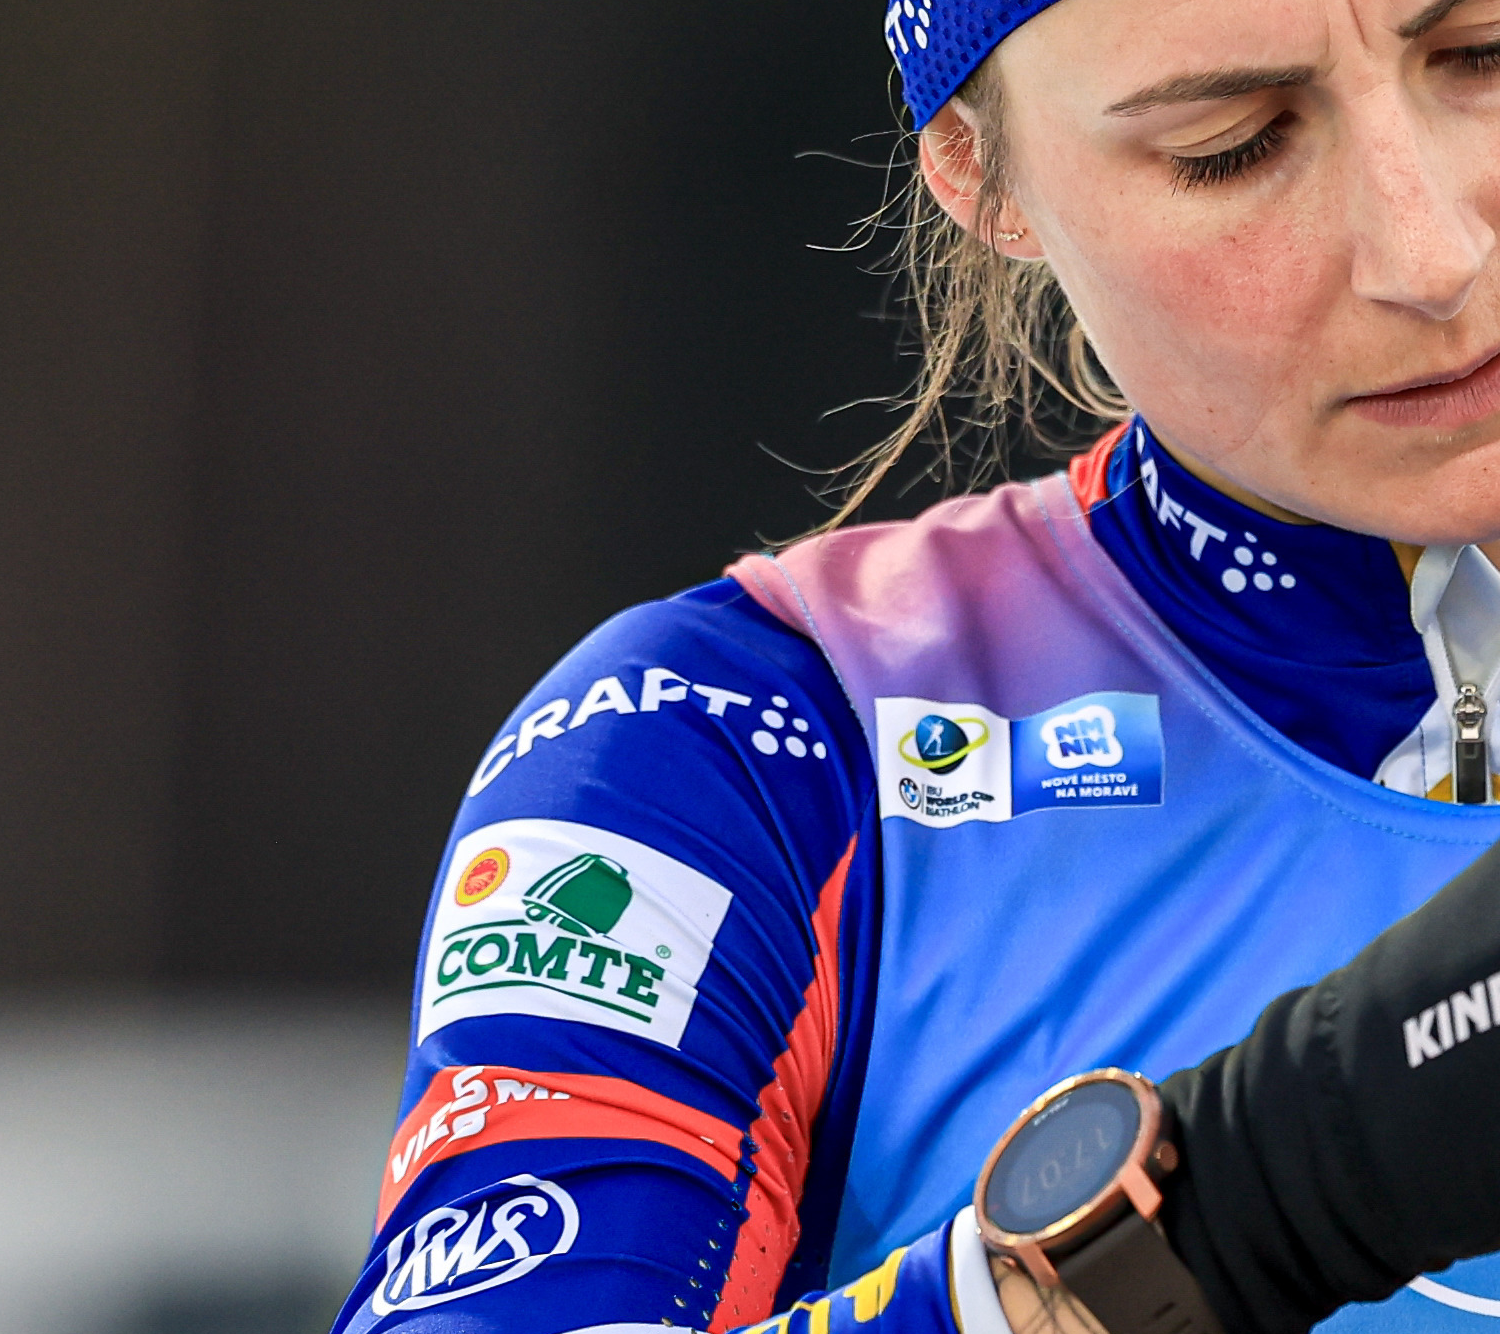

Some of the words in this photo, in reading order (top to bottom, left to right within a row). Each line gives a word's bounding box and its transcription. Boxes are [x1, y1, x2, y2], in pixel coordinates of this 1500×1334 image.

[469, 667, 752, 797] CRAFT
[1055, 787, 1077, 798] NA
[437, 933, 665, 1008] COMTE
